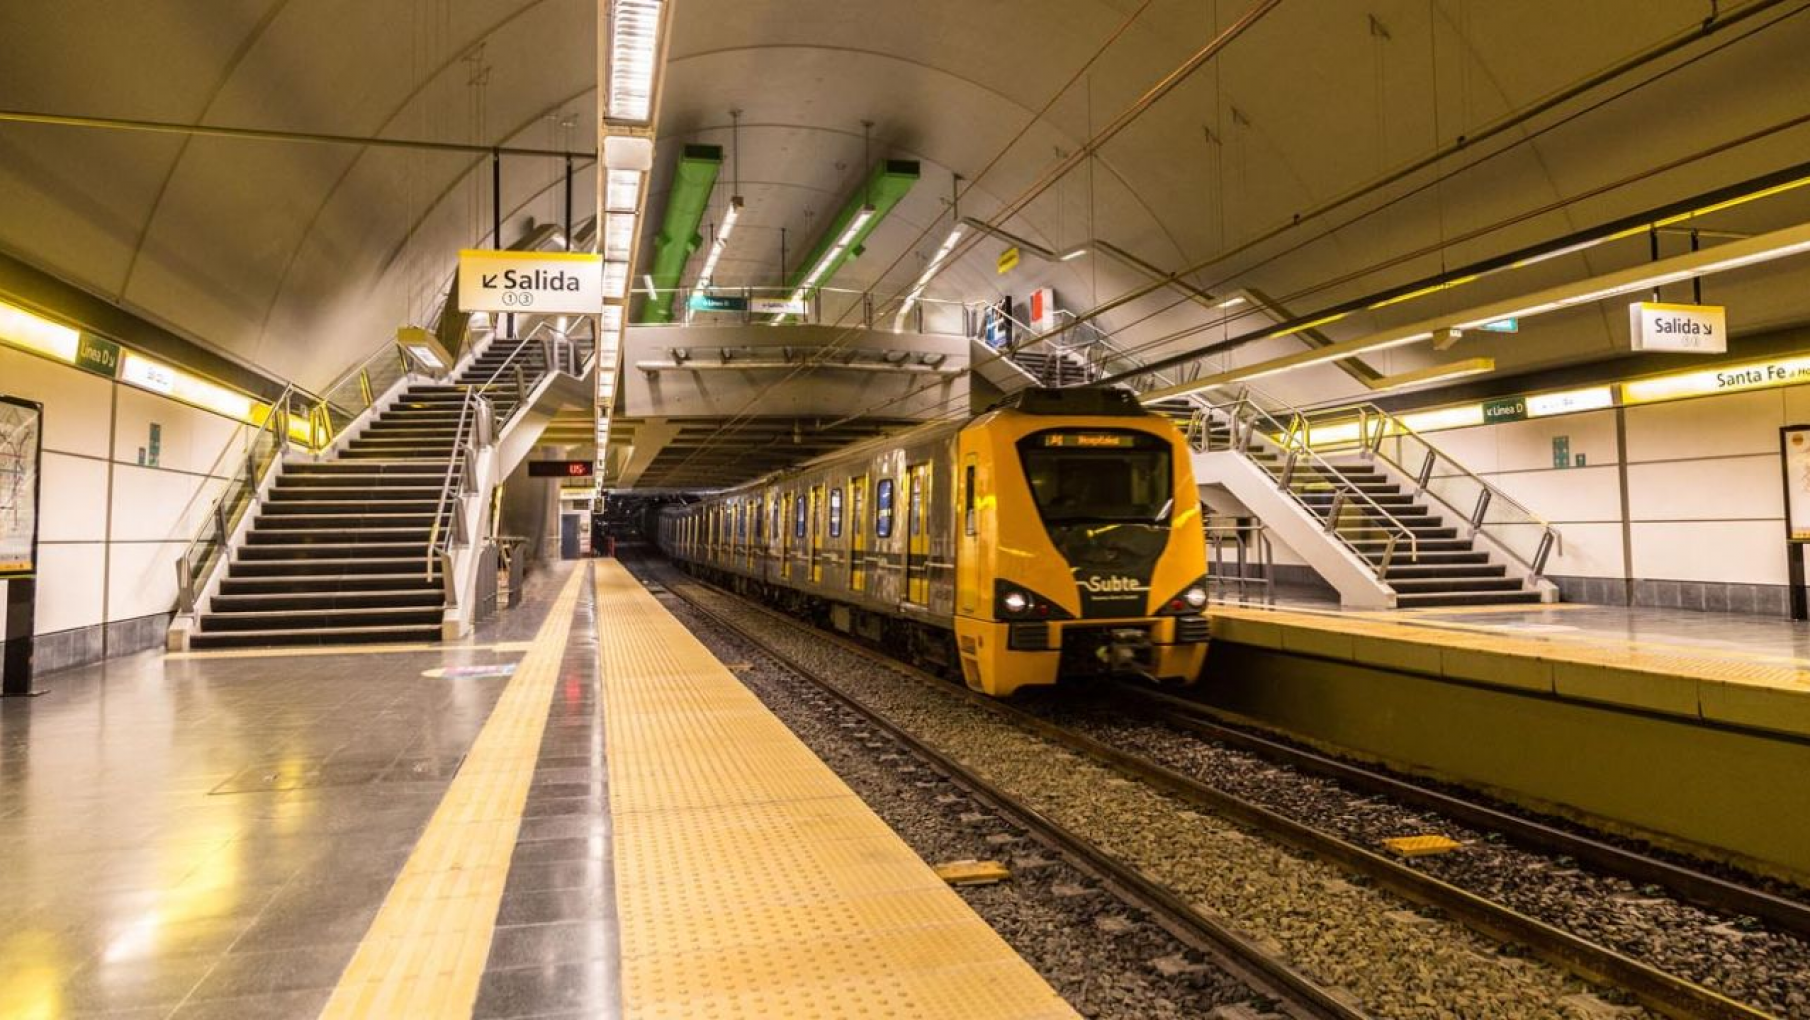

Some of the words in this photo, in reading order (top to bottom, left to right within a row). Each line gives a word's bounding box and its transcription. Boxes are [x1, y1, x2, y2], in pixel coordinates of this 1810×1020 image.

[503, 269, 580, 291] Salida
[1654, 317, 1701, 335] Salida
[102, 349, 110, 365] D
[1716, 370, 1763, 387] Santa
[1767, 365, 1787, 380] Fe
[1516, 403, 1524, 413] D
[1088, 574, 1140, 592] Subte
